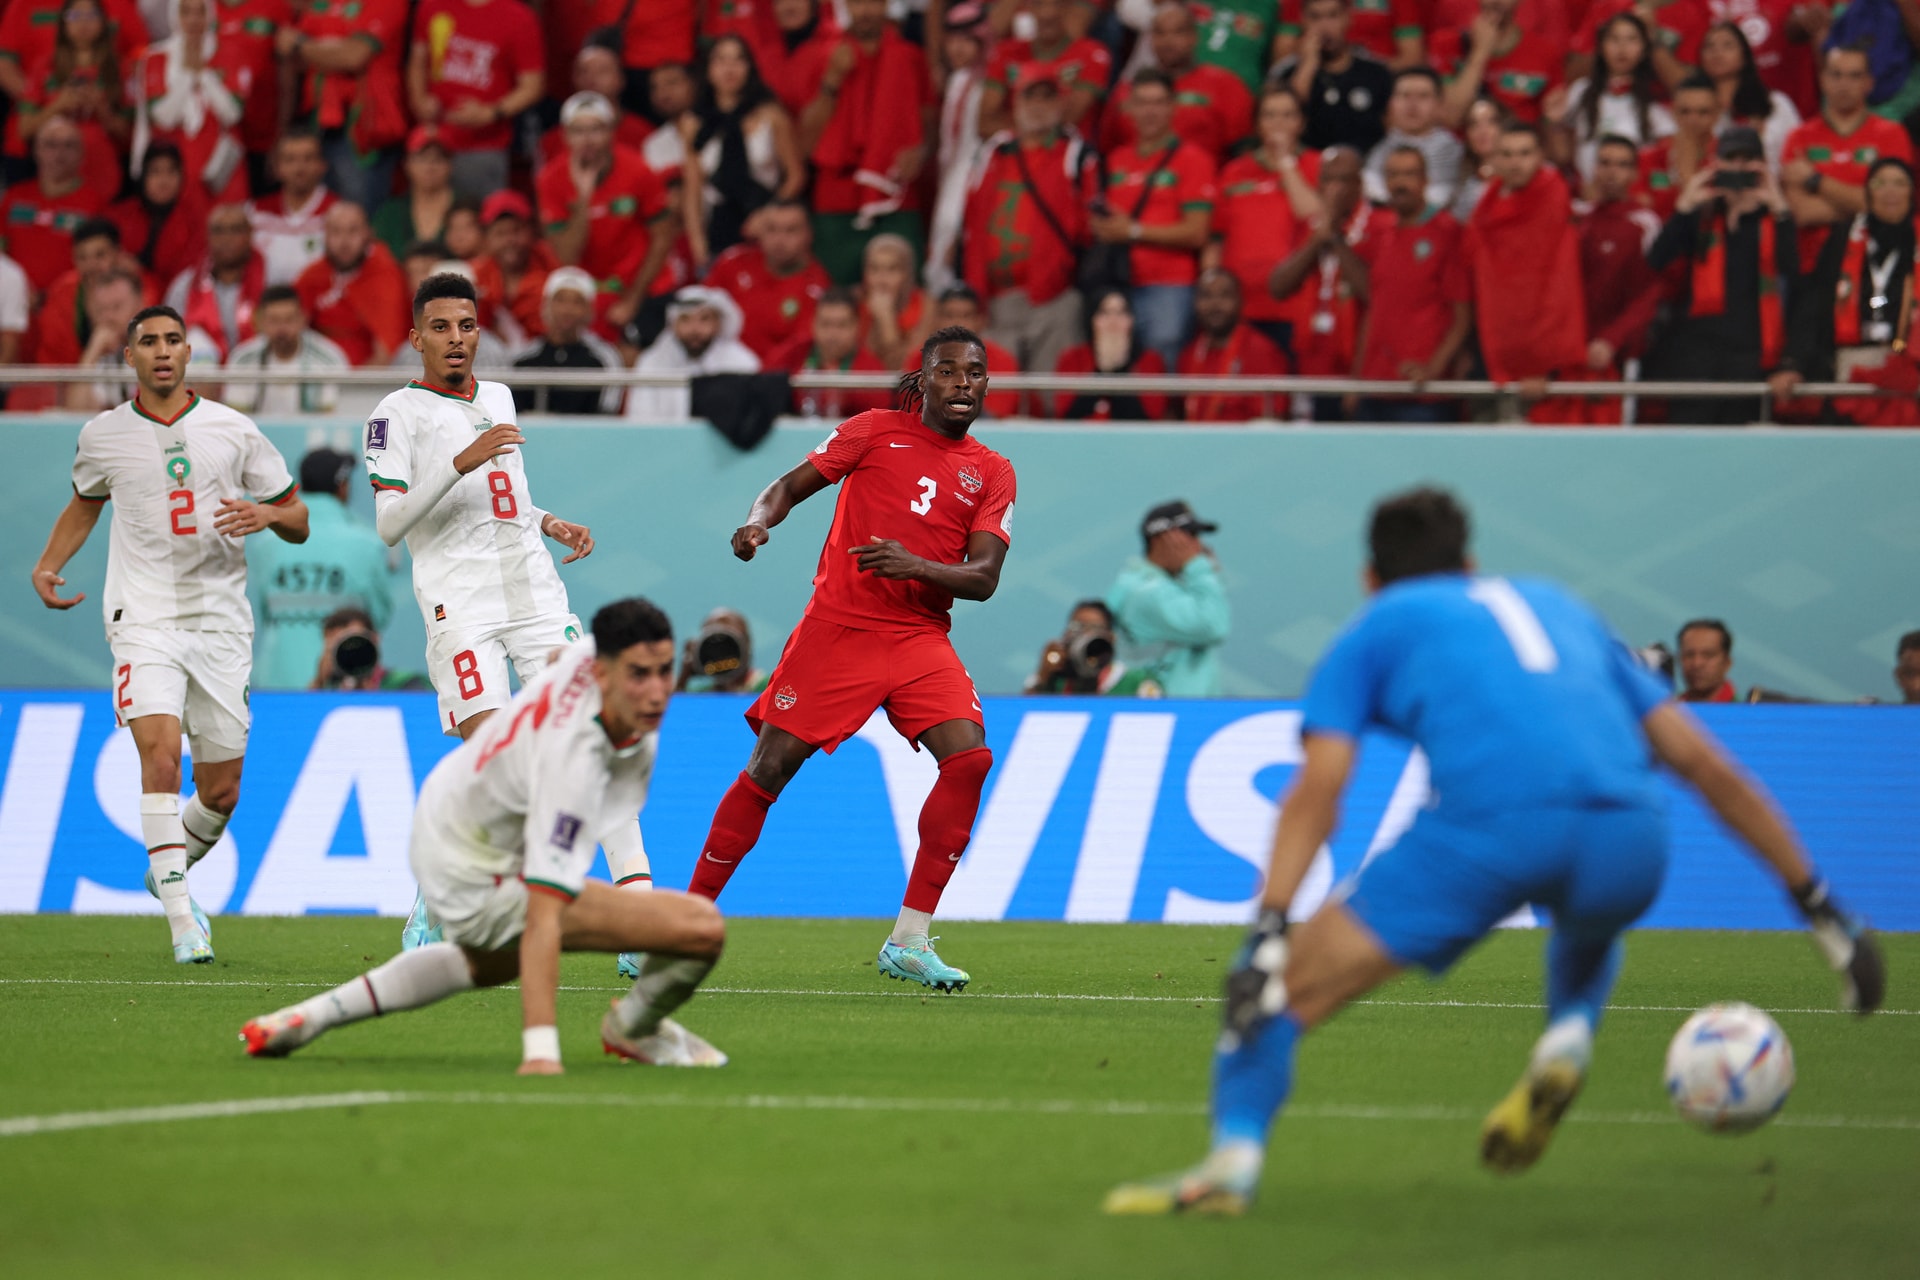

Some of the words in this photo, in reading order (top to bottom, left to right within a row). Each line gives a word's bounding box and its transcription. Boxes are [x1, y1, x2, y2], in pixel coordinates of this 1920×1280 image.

[488, 471, 517, 519] 8
[910, 475, 937, 516] 3
[958, 472, 982, 487] CANADA
[169, 490, 197, 535] 2
[1465, 578, 1559, 673] 1
[118, 663, 133, 709] 2
[453, 649, 484, 700] 8
[0, 703, 422, 916] ISA
[853, 710, 1541, 927] VIS
[161, 876, 183, 885] PUMA
